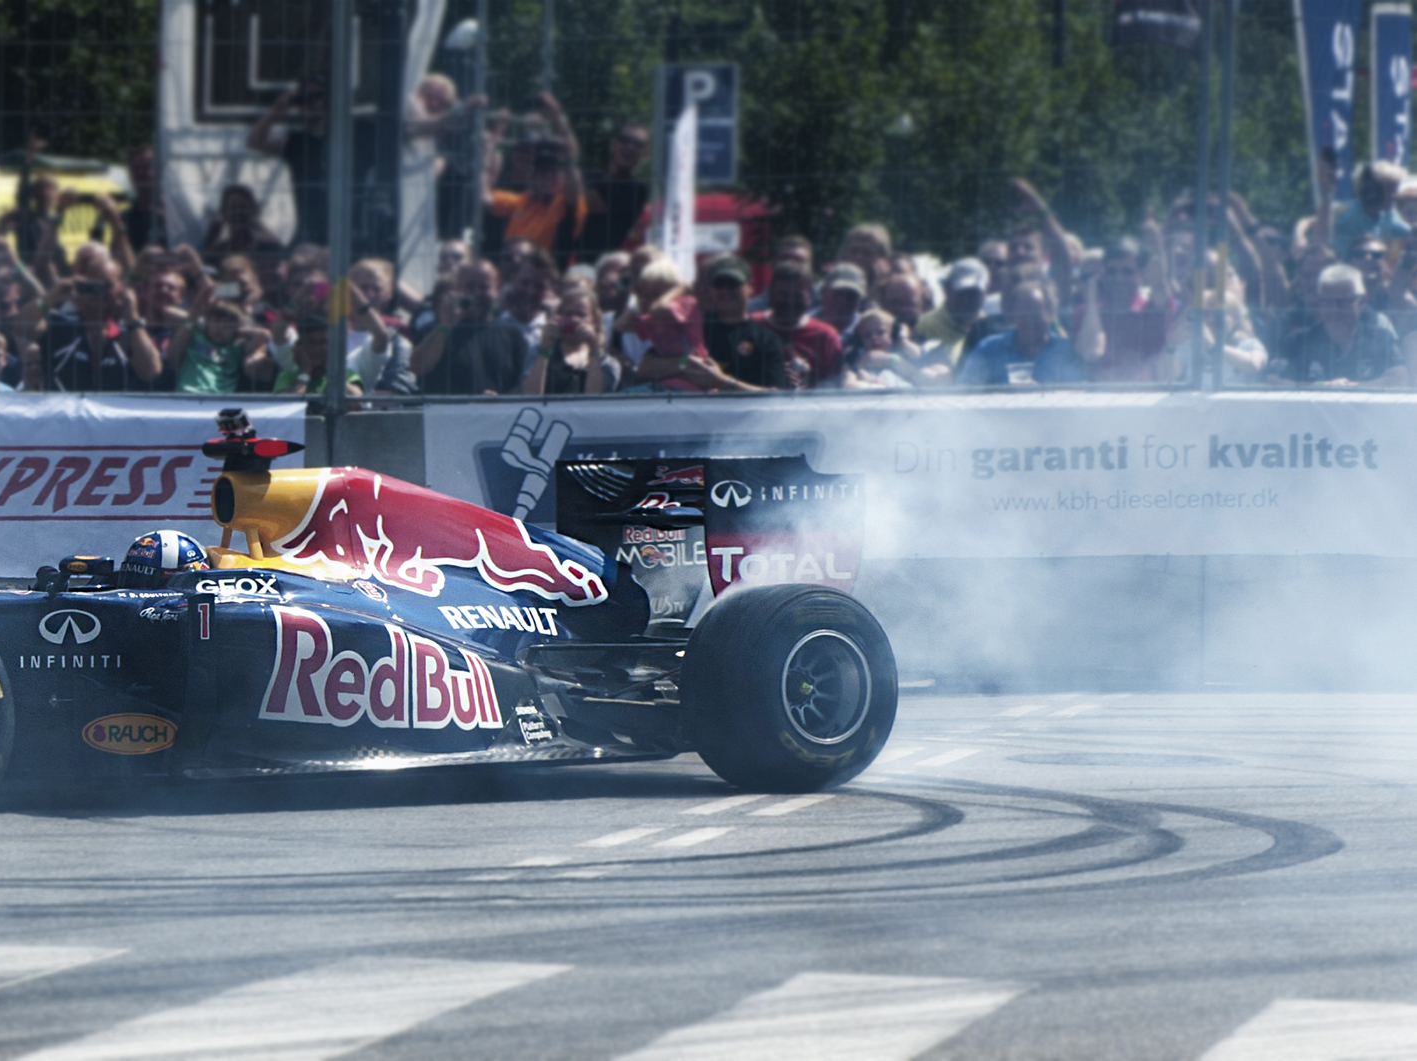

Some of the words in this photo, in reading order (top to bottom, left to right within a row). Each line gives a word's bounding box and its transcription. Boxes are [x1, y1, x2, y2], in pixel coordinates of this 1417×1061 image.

[685, 70, 716, 110] P
[893, 440, 958, 474] Din
[970, 435, 1128, 480] garanti
[1142, 434, 1197, 470] for
[1208, 432, 1379, 470] kvalitet
[761, 483, 860, 501] INFINITI
[992, 488, 1280, 512] www.kbh-dieselcenter.dk
[622, 526, 653, 544] Red
[655, 528, 686, 543] Bull
[616, 541, 707, 569] MOBILE
[711, 546, 853, 582] TOTAL
[121, 563, 157, 576] ENAULT
[195, 578, 280, 595] GEOX
[198, 603, 210, 640] 1
[437, 604, 559, 636] RENAULT
[20, 655, 121, 668] INFINITI
[259, 605, 409, 729] Red
[410, 630, 504, 730] Bull
[107, 723, 169, 742] RAUCH
